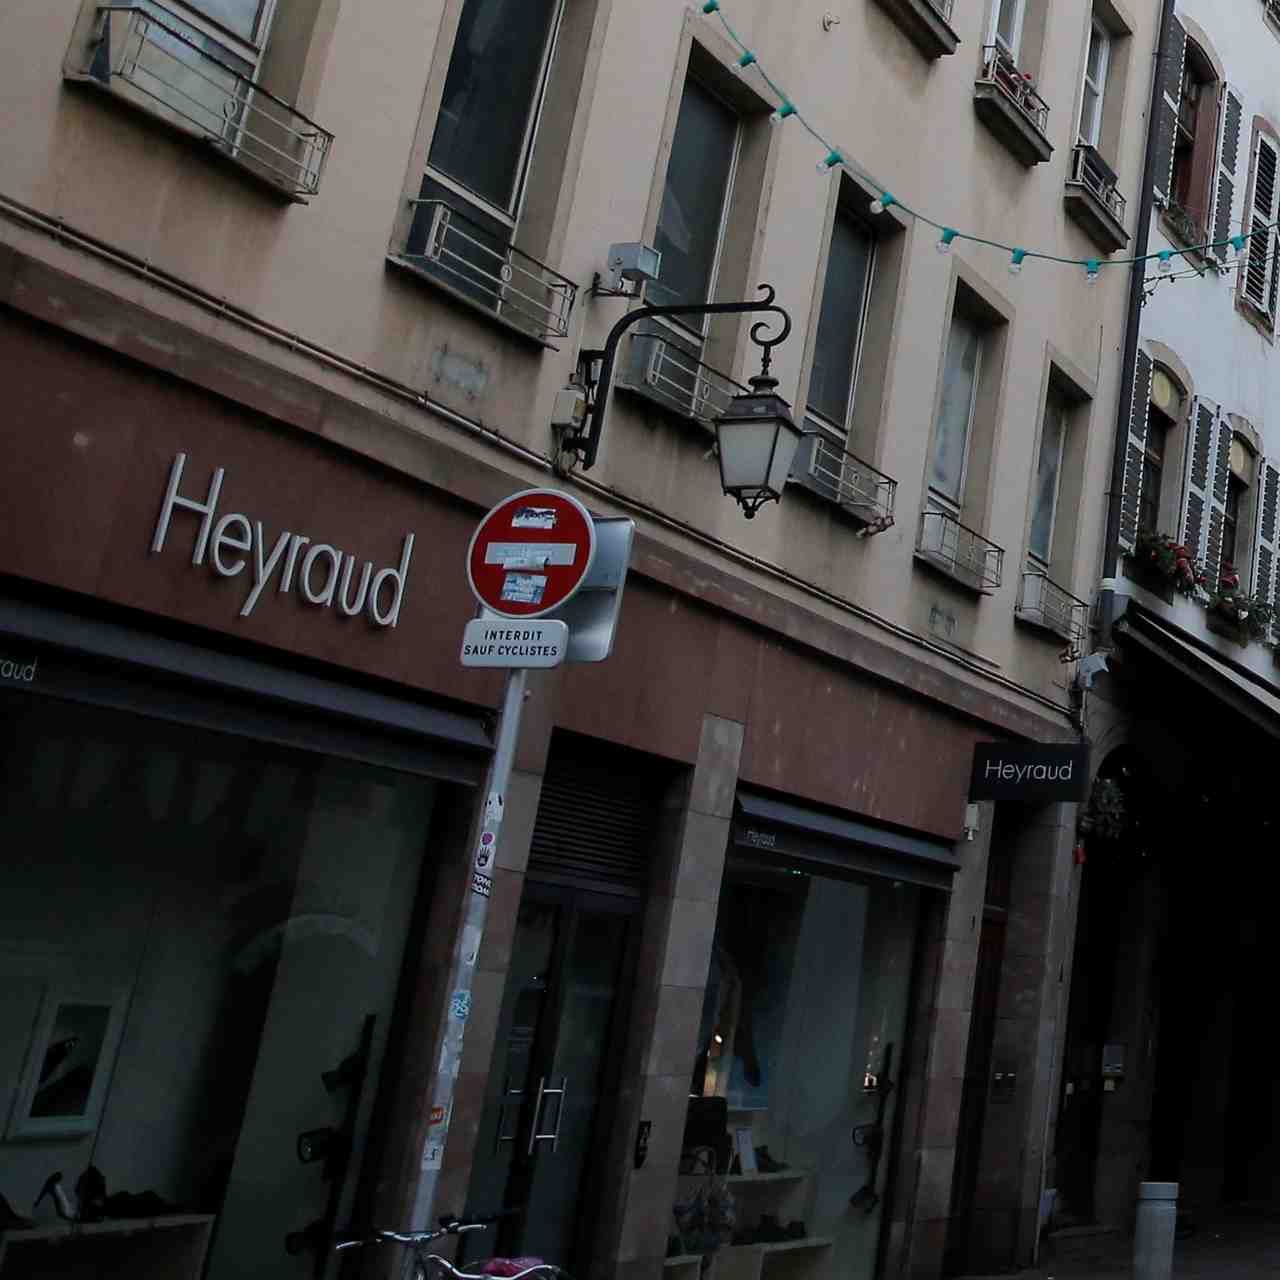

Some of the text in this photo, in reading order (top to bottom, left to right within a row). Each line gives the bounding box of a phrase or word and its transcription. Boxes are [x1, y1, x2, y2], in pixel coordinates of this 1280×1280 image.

[151, 451, 416, 628] Heyraud
[484, 630, 543, 641] INTERDIT
[463, 645, 558, 657] SAUF CYCLISTES
[0, 656, 40, 681] aud
[984, 759, 1073, 784] Heyraud
